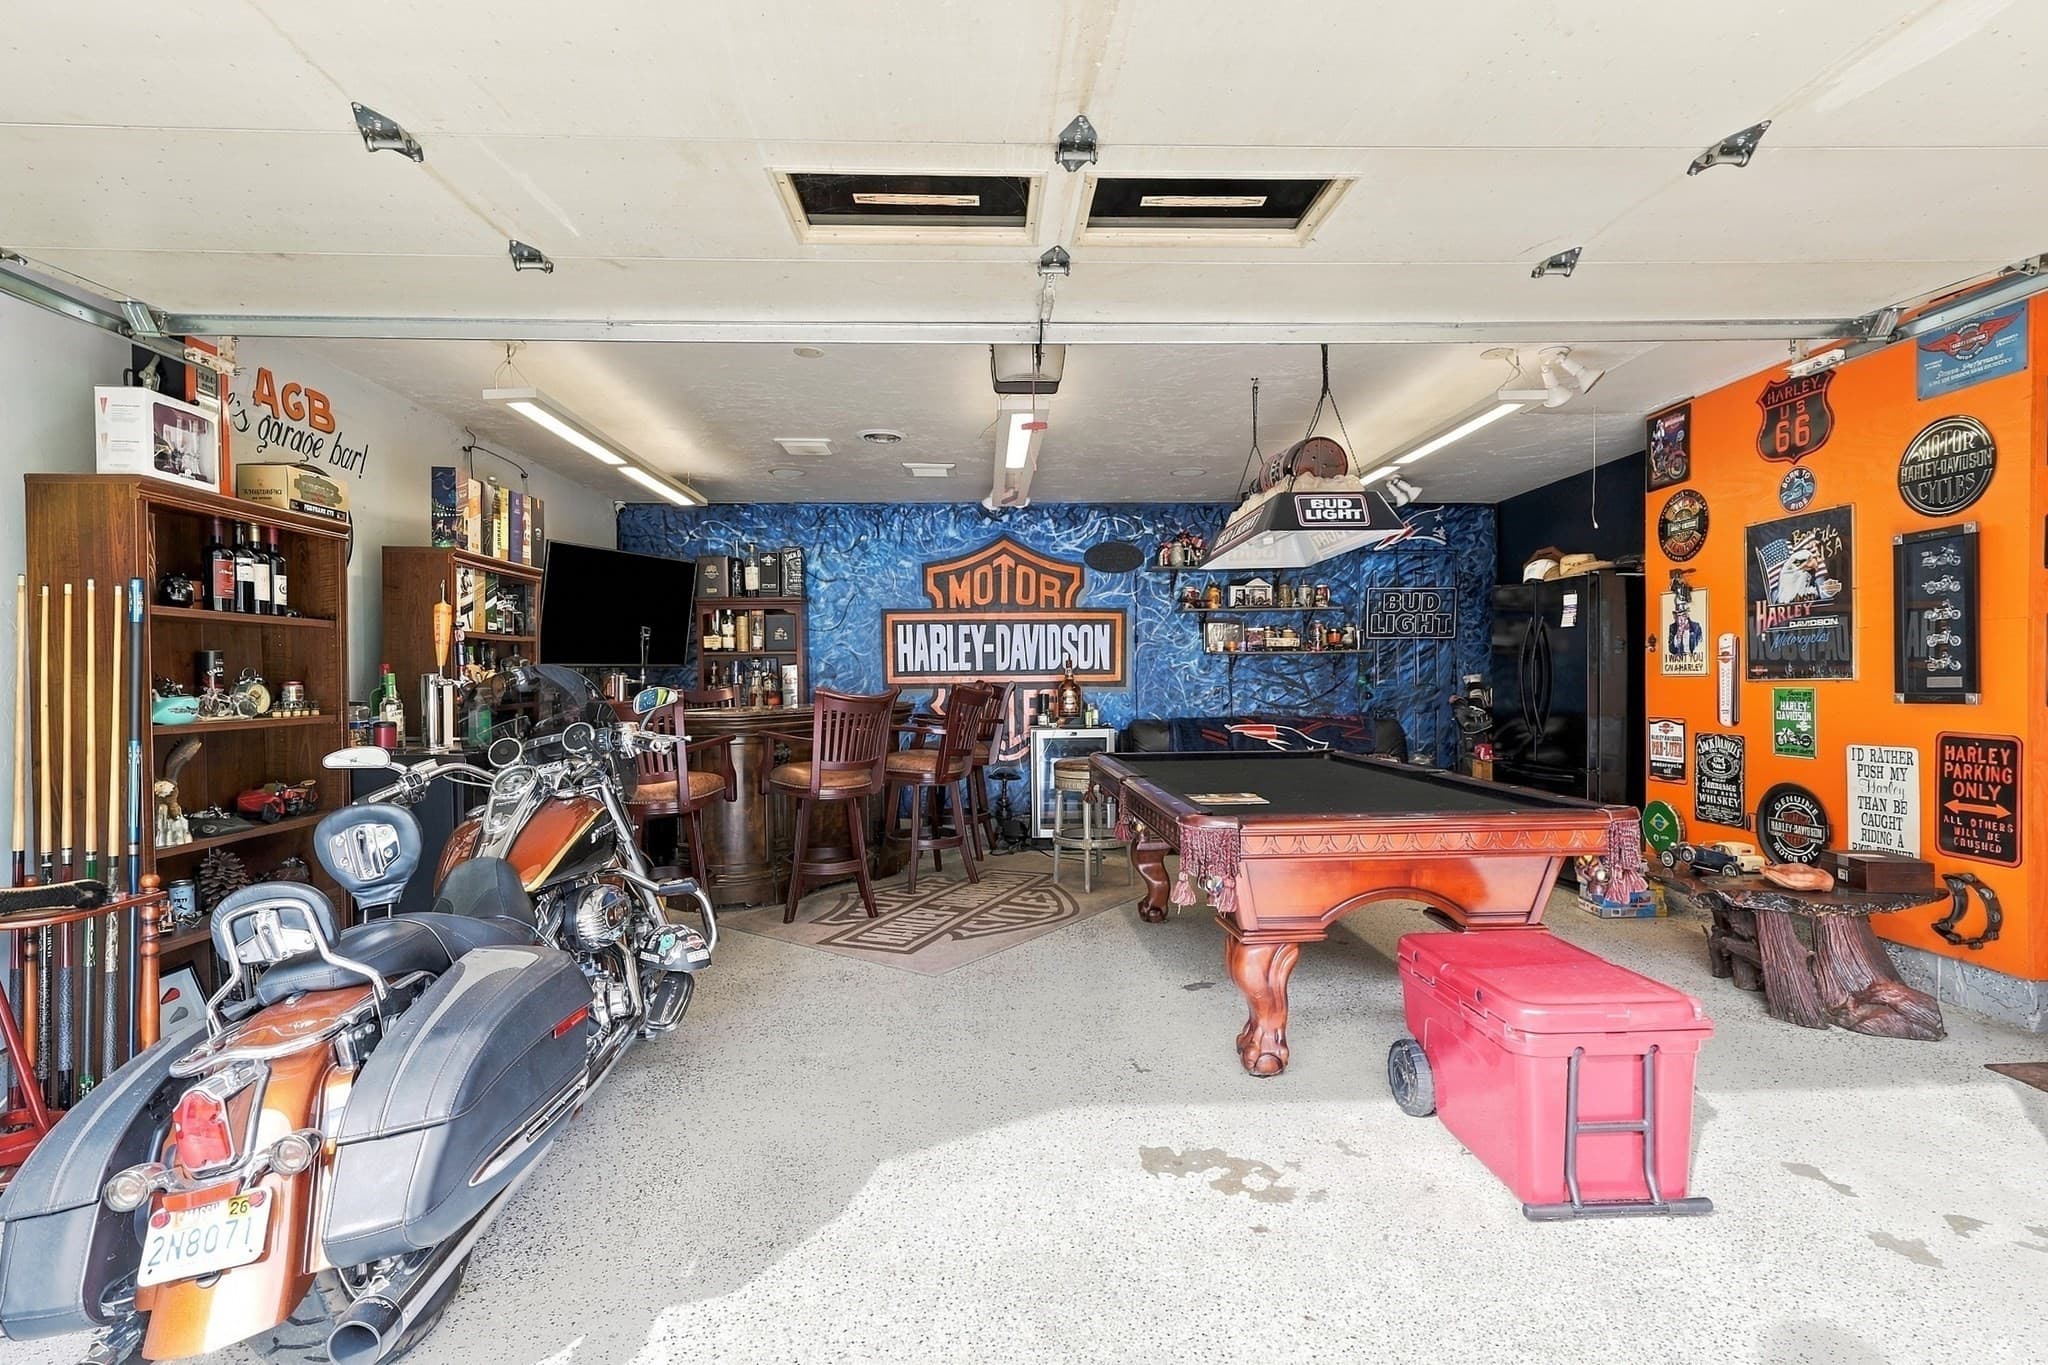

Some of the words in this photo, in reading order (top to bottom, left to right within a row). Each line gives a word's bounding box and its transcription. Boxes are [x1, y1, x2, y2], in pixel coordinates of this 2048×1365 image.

[252, 367, 336, 435] AGB
[1775, 413, 1811, 453] 66
[257, 415, 324, 463] garage
[328, 431, 369, 479] bar!
[1910, 428, 1978, 462] MOTOR
[1901, 448, 1994, 484] HARLEY-DAVIDSON
[1782, 469, 1800, 489] BORN
[1801, 469, 1811, 479] TO
[1917, 472, 1976, 505] CYCLES
[1310, 498, 1353, 509] BUD
[1790, 497, 1809, 510] RIDE
[1305, 508, 1363, 520] LIGHT
[949, 553, 1062, 609] MOTOR
[1383, 592, 1441, 613] BUD
[1756, 600, 1813, 636] HARLEY
[1789, 617, 1839, 628] DAVIDSON
[897, 623, 1110, 673] HARLEY-DAVIDSON
[1770, 626, 1831, 652] Motorcycles
[1669, 653, 1689, 662] WANT
[1690, 652, 1704, 662] YOU
[1776, 710, 1812, 721] DAVIDSON
[1870, 748, 1914, 766] RATHER
[1944, 745, 2010, 766] HARLEY
[1857, 763, 1884, 779] PUSH
[1889, 766, 1908, 781] MY
[1944, 761, 2013, 785] PARKING
[1858, 778, 1905, 800] Harley
[1953, 781, 2002, 801] ONLY
[1699, 793, 1740, 808] WHISKEY
[1774, 795, 1819, 816] GENUINE
[1857, 795, 1887, 812] THAN
[1893, 799, 1908, 815] BE
[1770, 820, 1823, 839] HARLEY-DAVIDSON
[1861, 812, 1904, 831] CAUGHT
[1943, 814, 1963, 826] ALL
[1970, 818, 2014, 833] OTHERS
[1861, 828, 1892, 846] RIDING
[1897, 833, 1904, 848] A
[1953, 826, 1979, 839] WILL
[1986, 831, 2001, 843] BE
[1773, 841, 1798, 862] MOTOR
[1801, 850, 1819, 863] OIL
[1953, 836, 2002, 854] CRUSHED
[229, 1199, 248, 1216] 26
[147, 1216, 253, 1268] 2N8071
